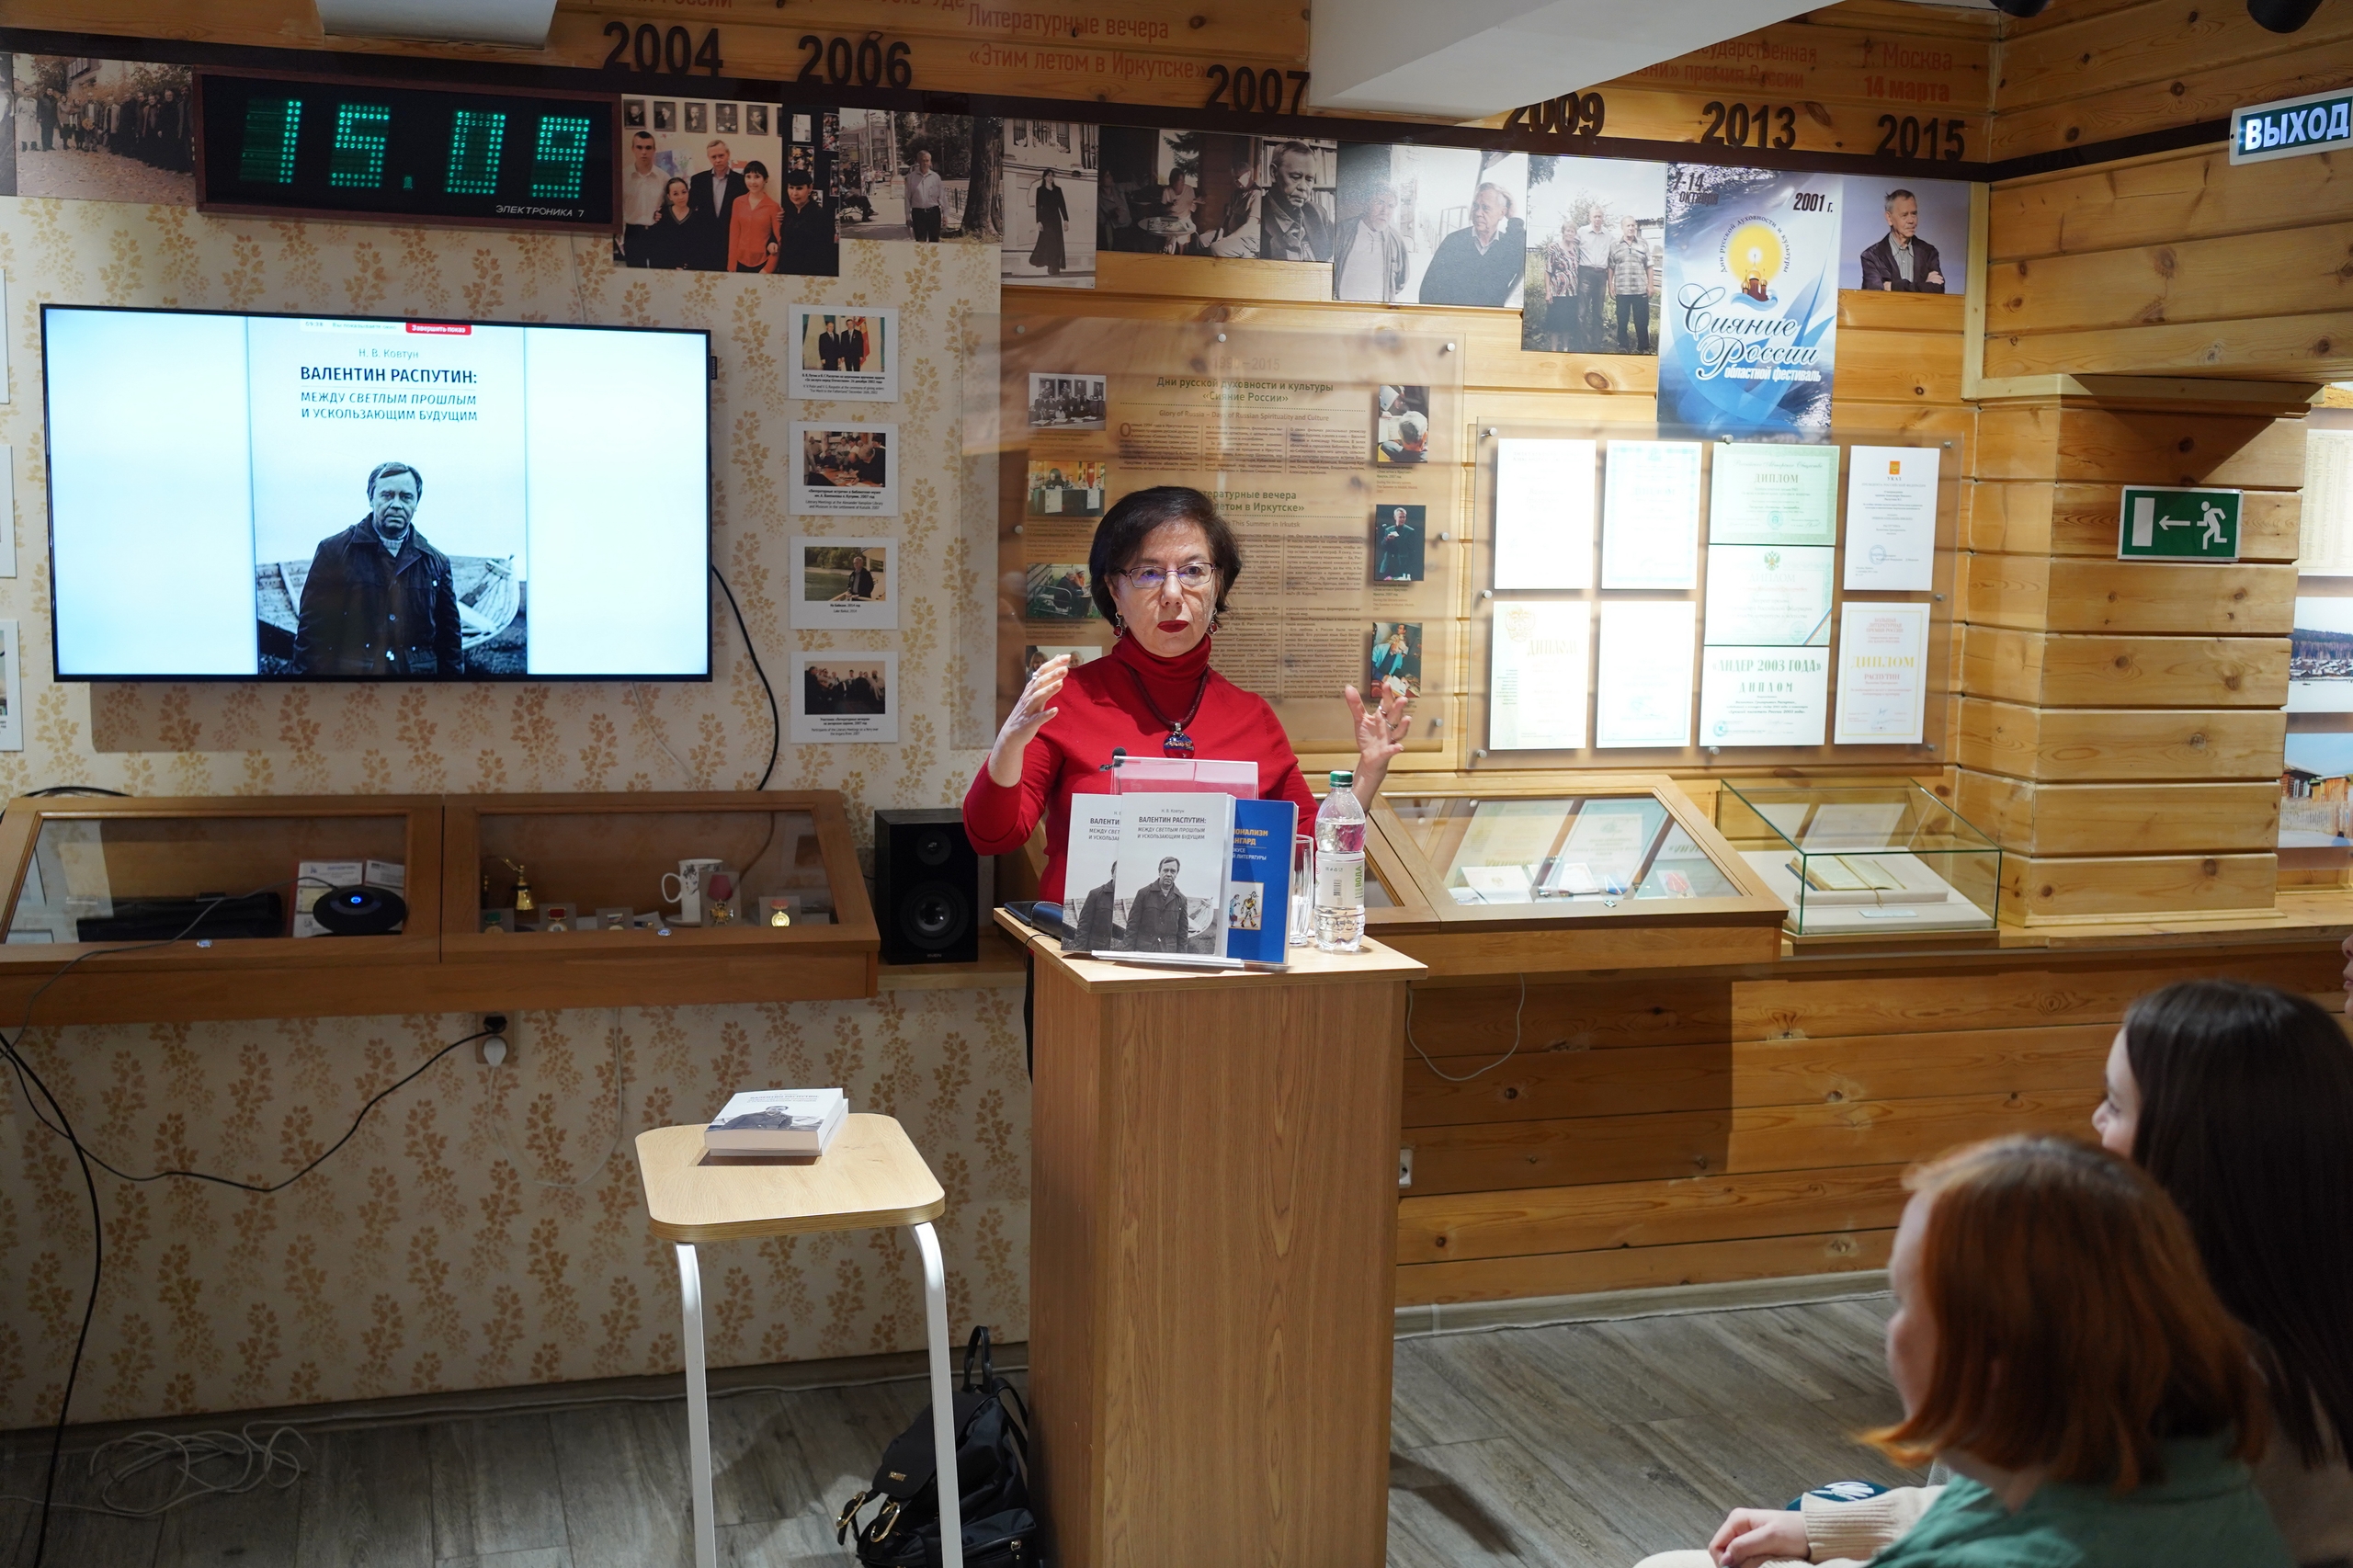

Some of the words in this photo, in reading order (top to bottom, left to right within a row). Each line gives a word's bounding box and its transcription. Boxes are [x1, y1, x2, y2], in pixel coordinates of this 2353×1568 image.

[968, 3, 1099, 37] Литературные
[1106, 18, 1169, 43] вечера
[603, 21, 723, 77] 2004
[1693, 39, 1817, 63] сударственная
[1883, 41, 1952, 71] Москва
[797, 35, 912, 90] 2006
[970, 43, 1028, 69] «Этим
[1034, 50, 1088, 72] летом
[1095, 57, 1105, 73] в
[1112, 52, 1206, 82] Иркутске»
[1685, 64, 1744, 87] премия
[1749, 65, 1804, 89] России
[1205, 63, 1310, 116] 2007
[1864, 75, 1884, 97] 14
[1889, 80, 1949, 103] марта
[1504, 92, 1606, 138] 2009
[1700, 101, 1797, 149] 2013
[2245, 102, 2349, 151] ВЫХОД
[1875, 114, 1966, 163] 2015
[1792, 192, 1826, 212] 2001
[1827, 202, 1834, 212] г.
[495, 204, 574, 218] ЭЛЕКТРОНИКА
[577, 209, 585, 218] 7
[1677, 283, 1799, 342] Сияние
[412, 324, 447, 334] Завершить
[448, 325, 466, 334] показ
[358, 348, 369, 358] Н.
[371, 348, 381, 358] В.
[383, 348, 419, 360] Ковтун
[1696, 335, 1819, 381] России
[301, 367, 386, 381] ВАЛЕНТИН
[391, 369, 478, 384] РАСПУТИН:
[1724, 366, 1771, 381] областной
[1772, 365, 1822, 382] фестиваль
[1156, 375, 1177, 388] Дни
[1179, 377, 1218, 391] русской
[1221, 380, 1277, 392] духовности
[1279, 381, 1286, 390] и
[1289, 382, 1334, 394] культуры
[301, 392, 346, 403] МЕЖДУ
[349, 392, 407, 404] СВЕТЛЫМ
[411, 394, 476, 405] ПРОШЛЫМ
[1202, 391, 1245, 402] «Сияние
[1248, 392, 1289, 403] России»
[301, 408, 310, 418] И
[313, 409, 415, 421] УСКОЛЬЗАЮЩИМ
[419, 411, 478, 423] БУДУЩИМ
[1159, 409, 1176, 419] Glory
[1176, 409, 1184, 417] of
[1185, 410, 1205, 418] Russia
[1235, 412, 1258, 420] Russian
[1260, 413, 1294, 424] Spirituality
[1306, 414, 1329, 423] Culture
[1754, 473, 1799, 483] ДИПЛОМ
[1203, 490, 1259, 501] ературные
[1262, 492, 1297, 503] вечера
[1254, 502, 1305, 514] Иркутске»
[1246, 520, 1270, 528] Summer
[1279, 521, 1301, 530] Irkutsk
[1749, 573, 1796, 584] ДИПЛОМ
[1712, 659, 1754, 673] «ЛИДЕР
[1757, 659, 1785, 672] 2003
[1788, 659, 1822, 674] ГОДА»
[1850, 656, 1915, 669] ДИПЛОМ
[1864, 673, 1900, 681] РАСПУТИН
[1738, 681, 1793, 693] ДИПЛОМ
[1089, 817, 1120, 826] ВАЛЕНТИ
[1138, 816, 1171, 824] ВАЛЕНТИН
[1172, 817, 1207, 825] РАСПУТИН:
[1233, 837, 1256, 846] НГАРД
